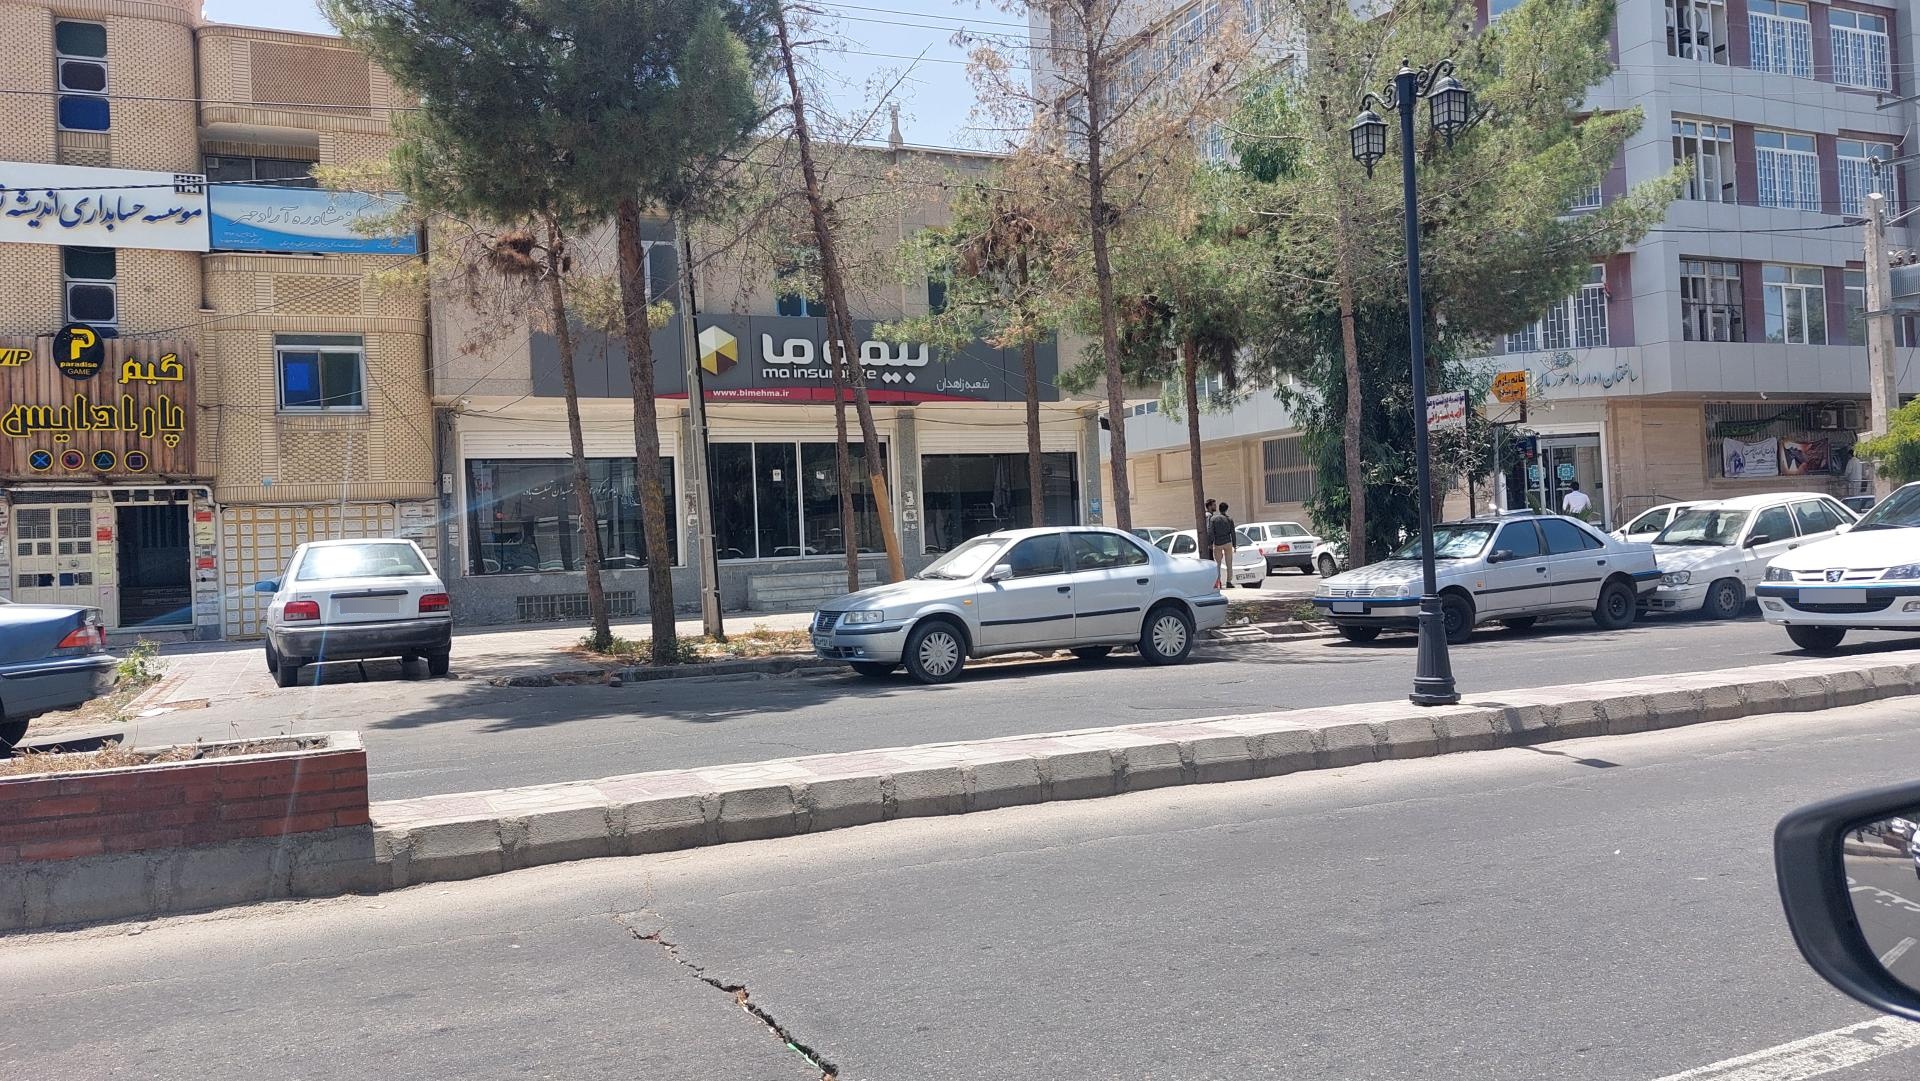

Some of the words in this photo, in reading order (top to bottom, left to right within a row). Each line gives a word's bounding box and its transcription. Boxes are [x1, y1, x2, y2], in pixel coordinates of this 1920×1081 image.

[59, 194, 145, 232] حسابداری
[291, 205, 343, 226] مشاوره
[762, 333, 814, 364] ما
[67, 368, 92, 376] GAME
[118, 353, 185, 385] گیم
[762, 368, 790, 379] ma
[712, 389, 790, 397] www.bimehma.ir
[936, 377, 966, 392] زاهدان
[965, 377, 990, 393] شعبه
[1, 394, 185, 448] پارادایس
